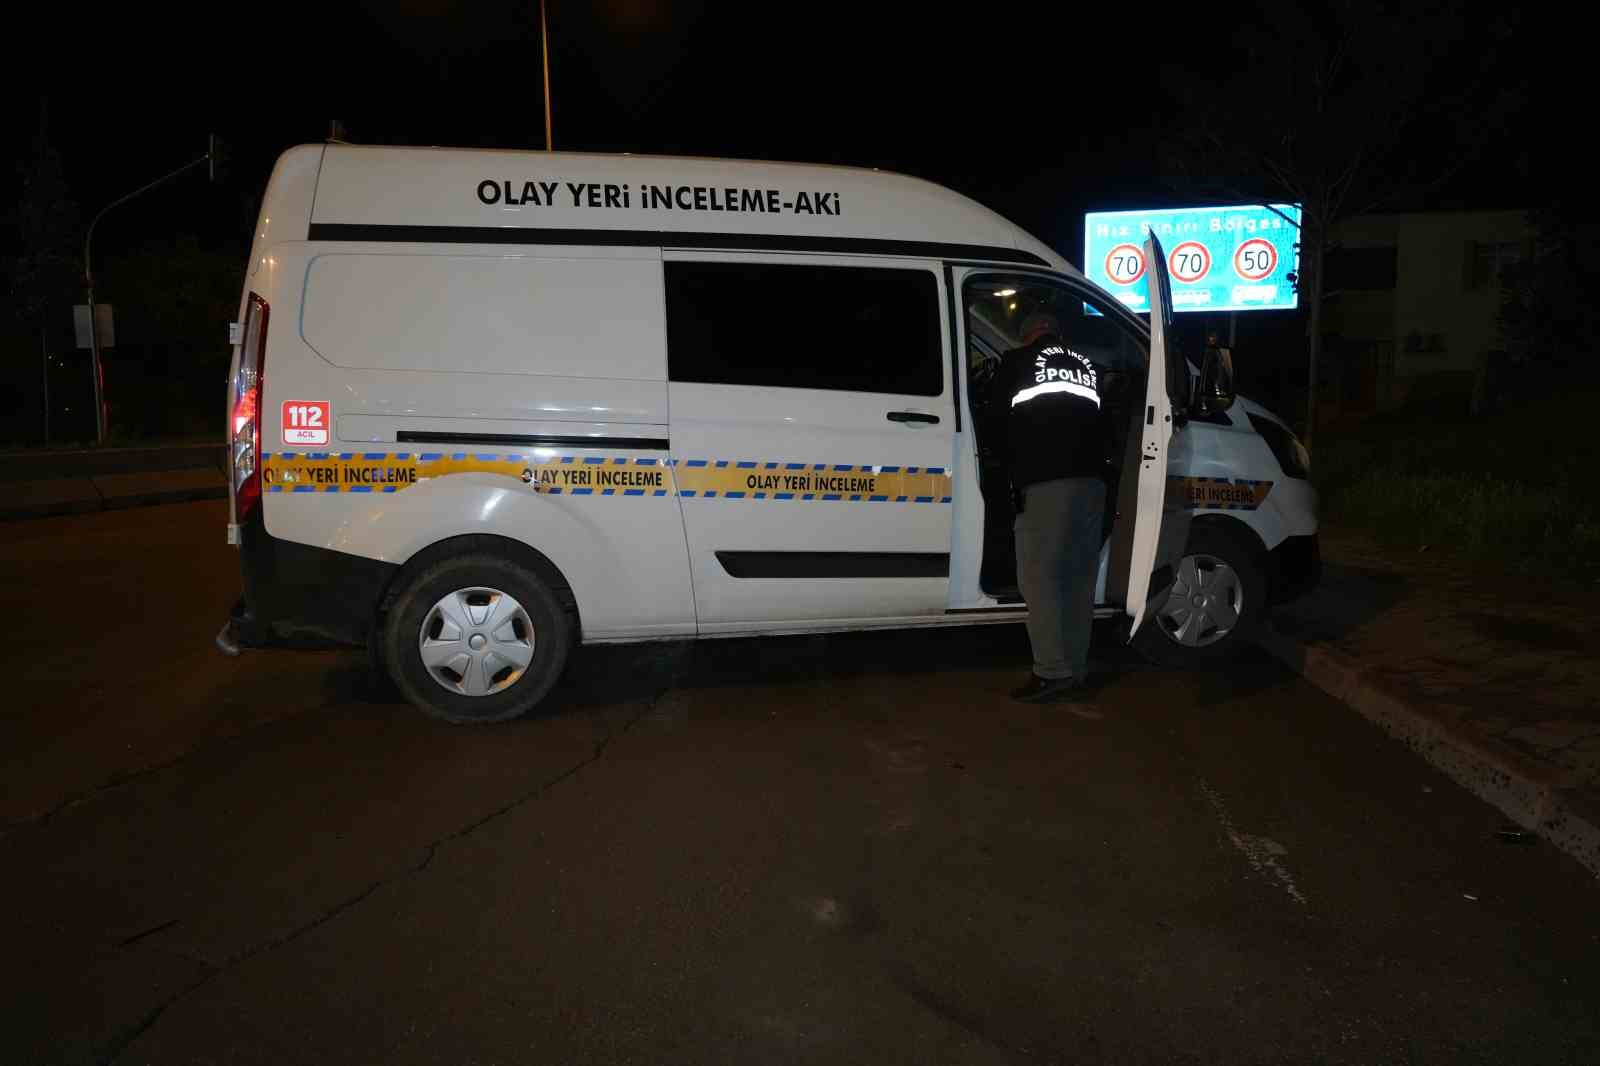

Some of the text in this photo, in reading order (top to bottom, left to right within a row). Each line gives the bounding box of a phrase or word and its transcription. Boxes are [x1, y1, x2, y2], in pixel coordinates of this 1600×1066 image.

[477, 179, 559, 206] OLAY
[1113, 256, 1139, 276] 70
[1178, 253, 1203, 273] 70
[1244, 250, 1270, 271] 50
[1035, 355, 1047, 383] OLAY
[288, 405, 323, 427] 112
[746, 475, 781, 489] OLAY
